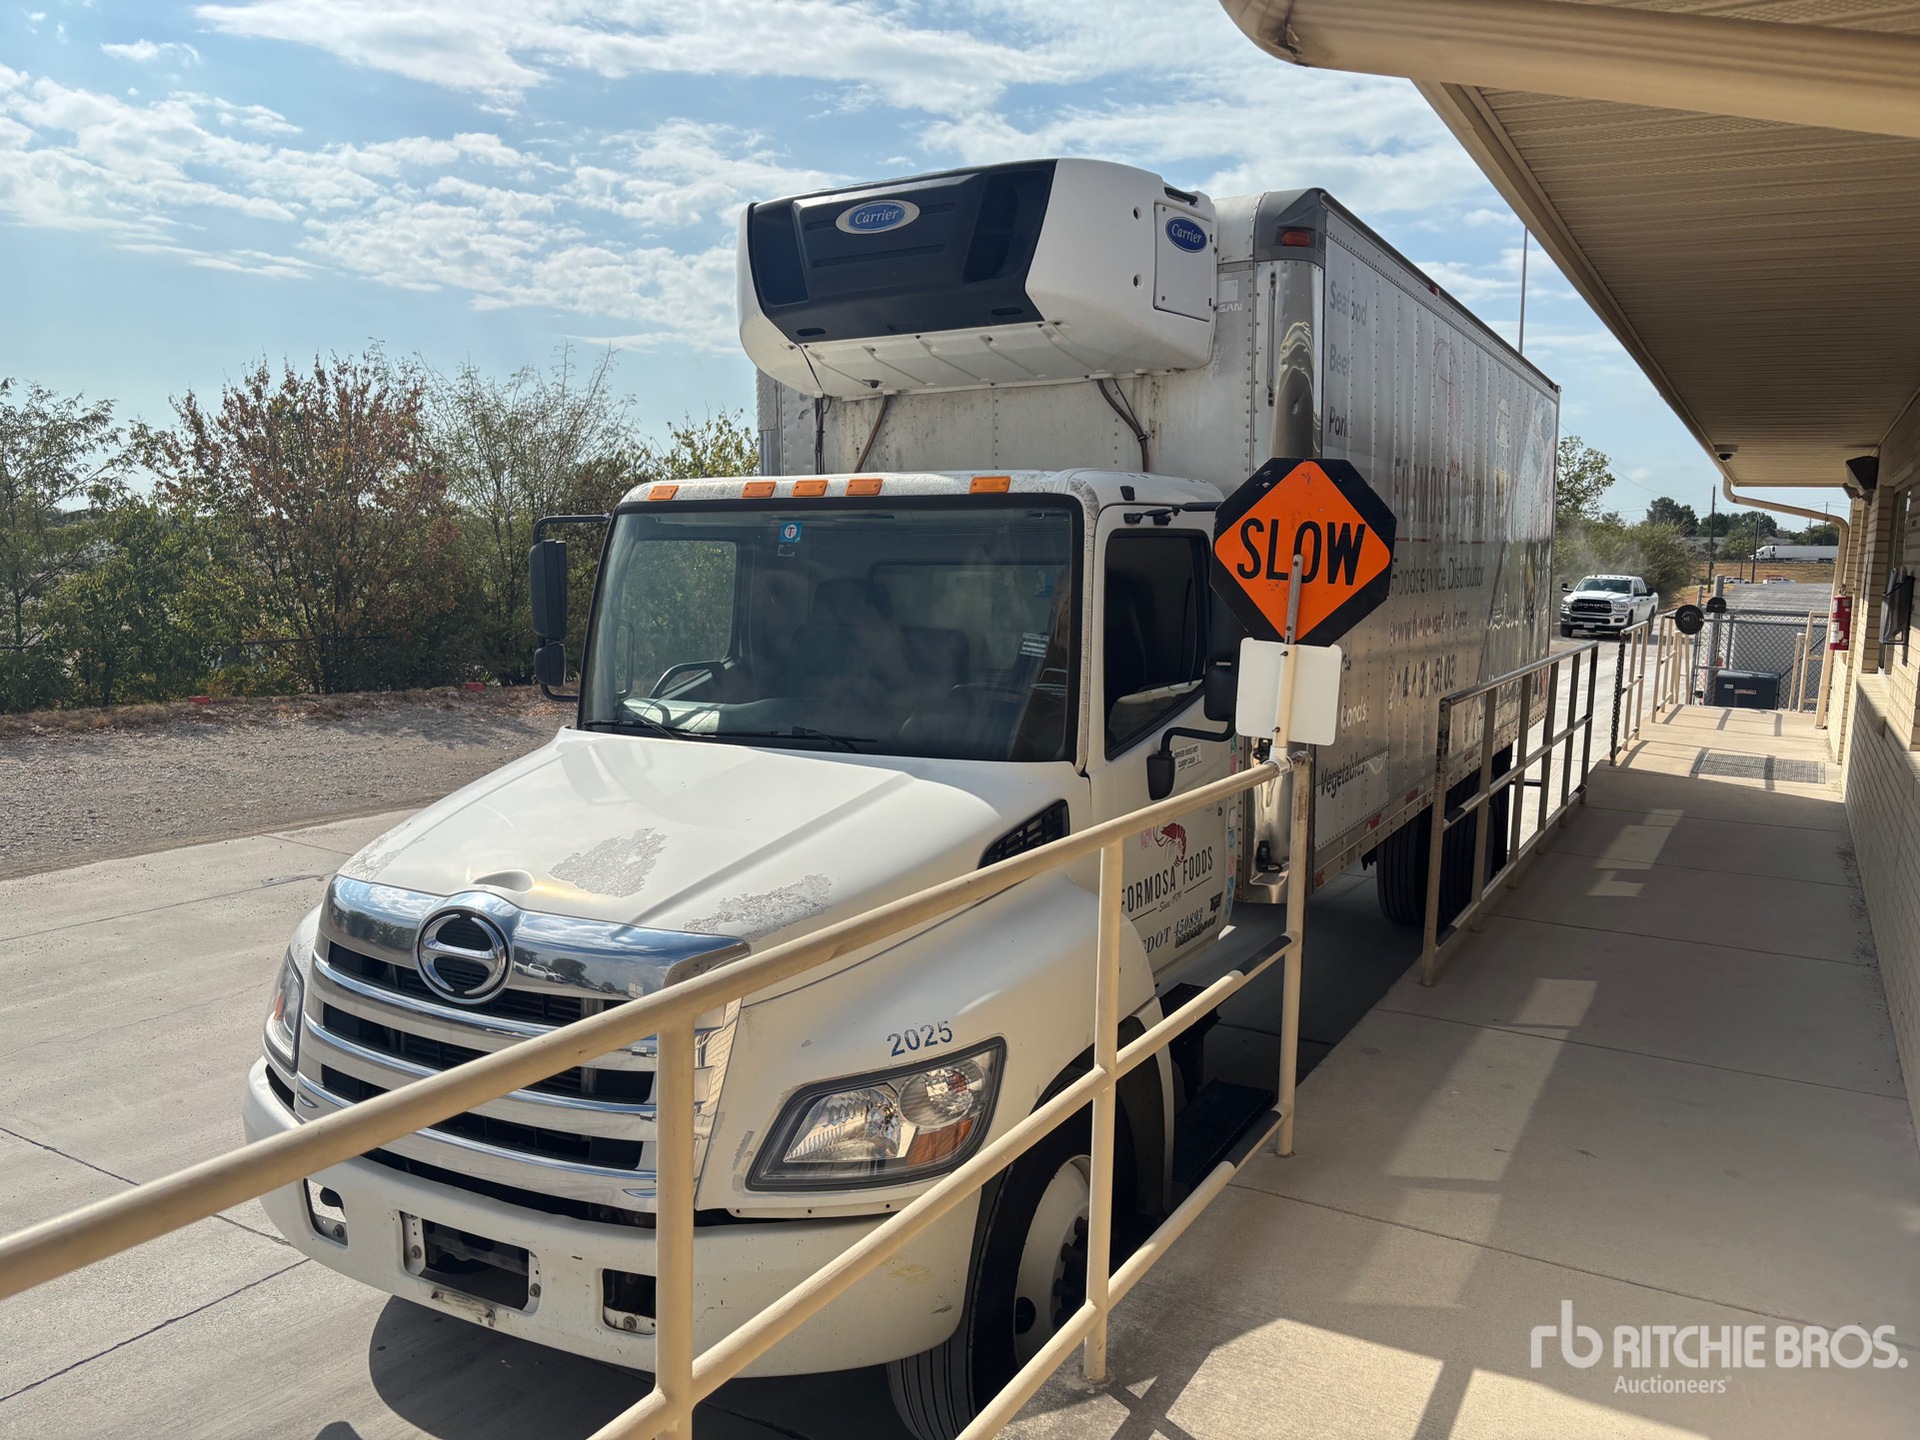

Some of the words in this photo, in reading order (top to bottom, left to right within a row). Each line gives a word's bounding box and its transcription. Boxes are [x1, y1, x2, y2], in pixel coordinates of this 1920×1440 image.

[855, 209, 899, 225] Carrier
[1171, 223, 1203, 244] Carrier
[1236, 517, 1367, 587] SLOW
[1448, 556, 1485, 589] Distributor
[1320, 751, 1366, 798] Vegetables
[1182, 846, 1213, 885] FOODS
[886, 1020, 953, 1057] 2025
